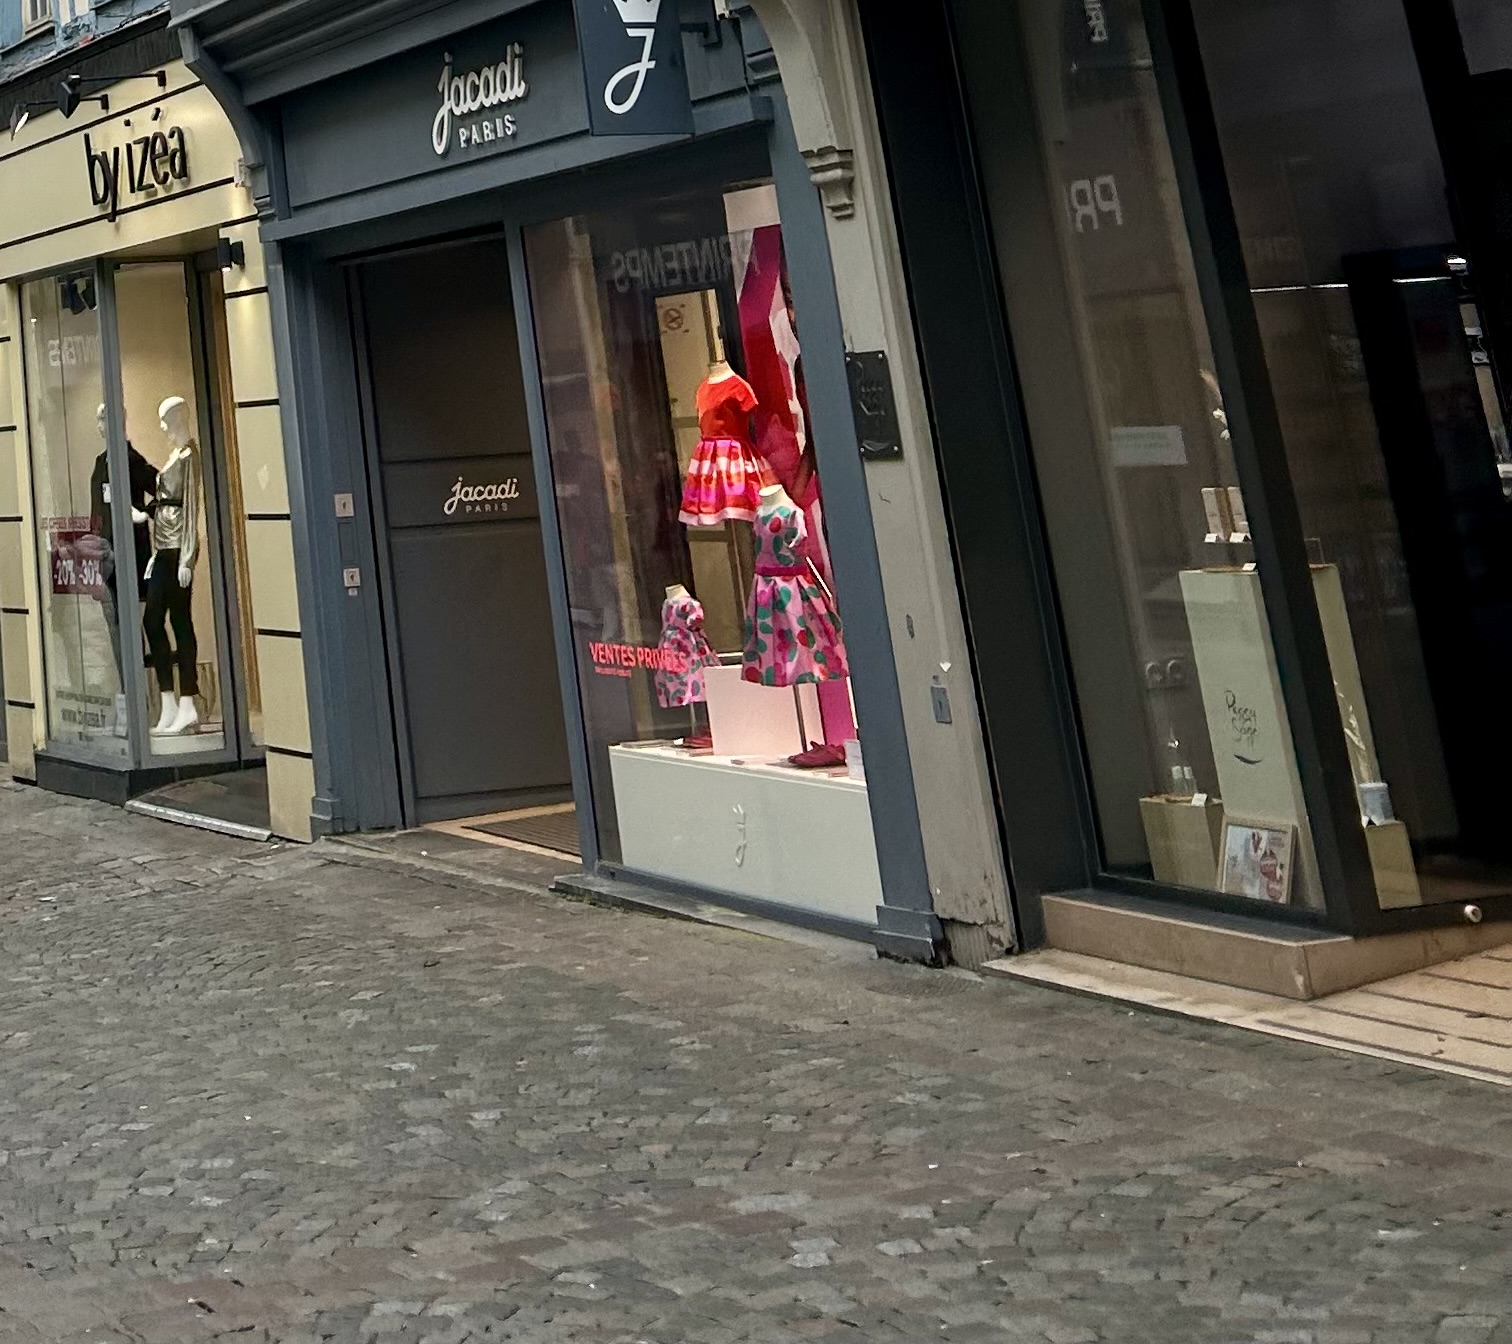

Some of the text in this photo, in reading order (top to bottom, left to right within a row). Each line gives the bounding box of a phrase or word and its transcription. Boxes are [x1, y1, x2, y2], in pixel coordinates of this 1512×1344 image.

[432, 42, 529, 155] jacadi
[458, 114, 517, 149] PARIS
[84, 107, 189, 223] by izéa
[443, 476, 520, 515] jacadi
[465, 502, 508, 513] PARIS
[589, 641, 636, 667] VENTES
